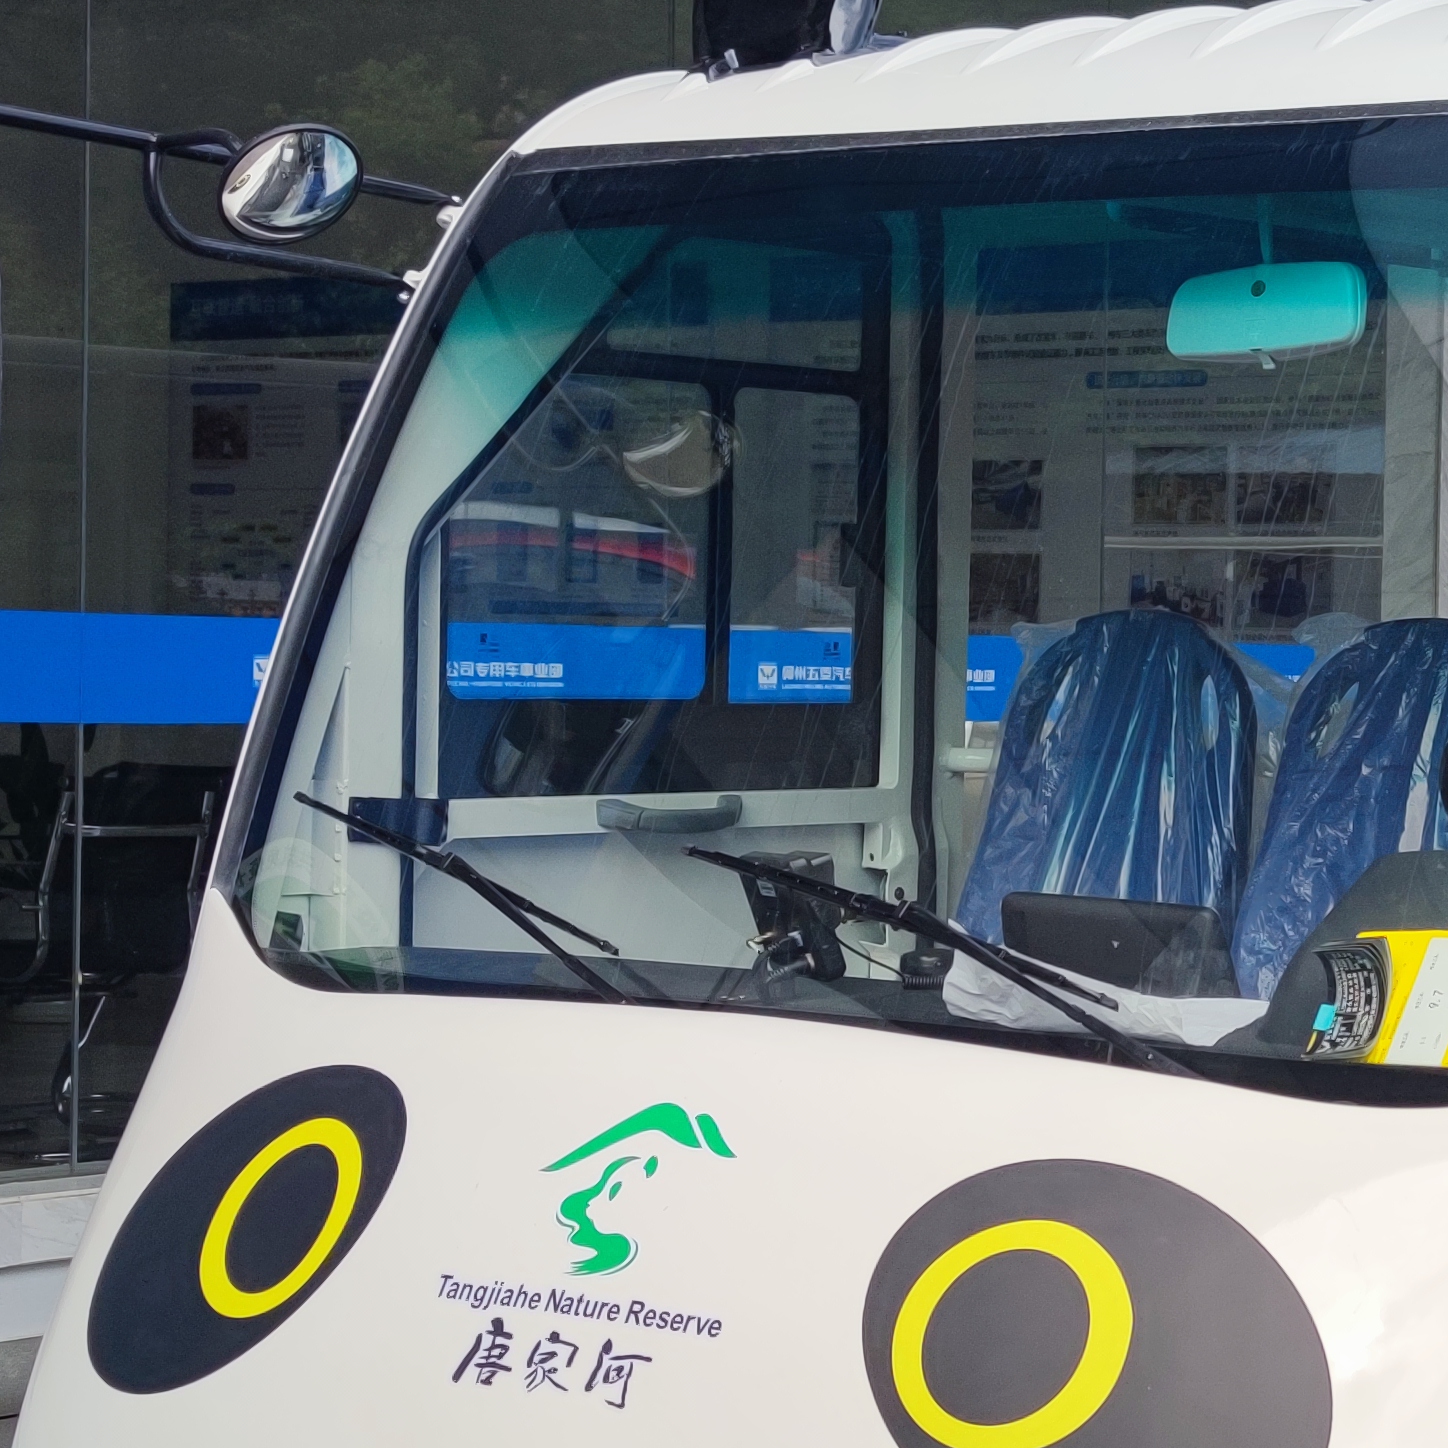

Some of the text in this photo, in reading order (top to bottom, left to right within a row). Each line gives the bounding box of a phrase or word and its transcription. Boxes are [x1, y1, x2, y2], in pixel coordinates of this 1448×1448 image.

[437, 1273, 723, 1338] Tangjiahe Nature Reserve
[451, 1317, 653, 1410] 唐家河
